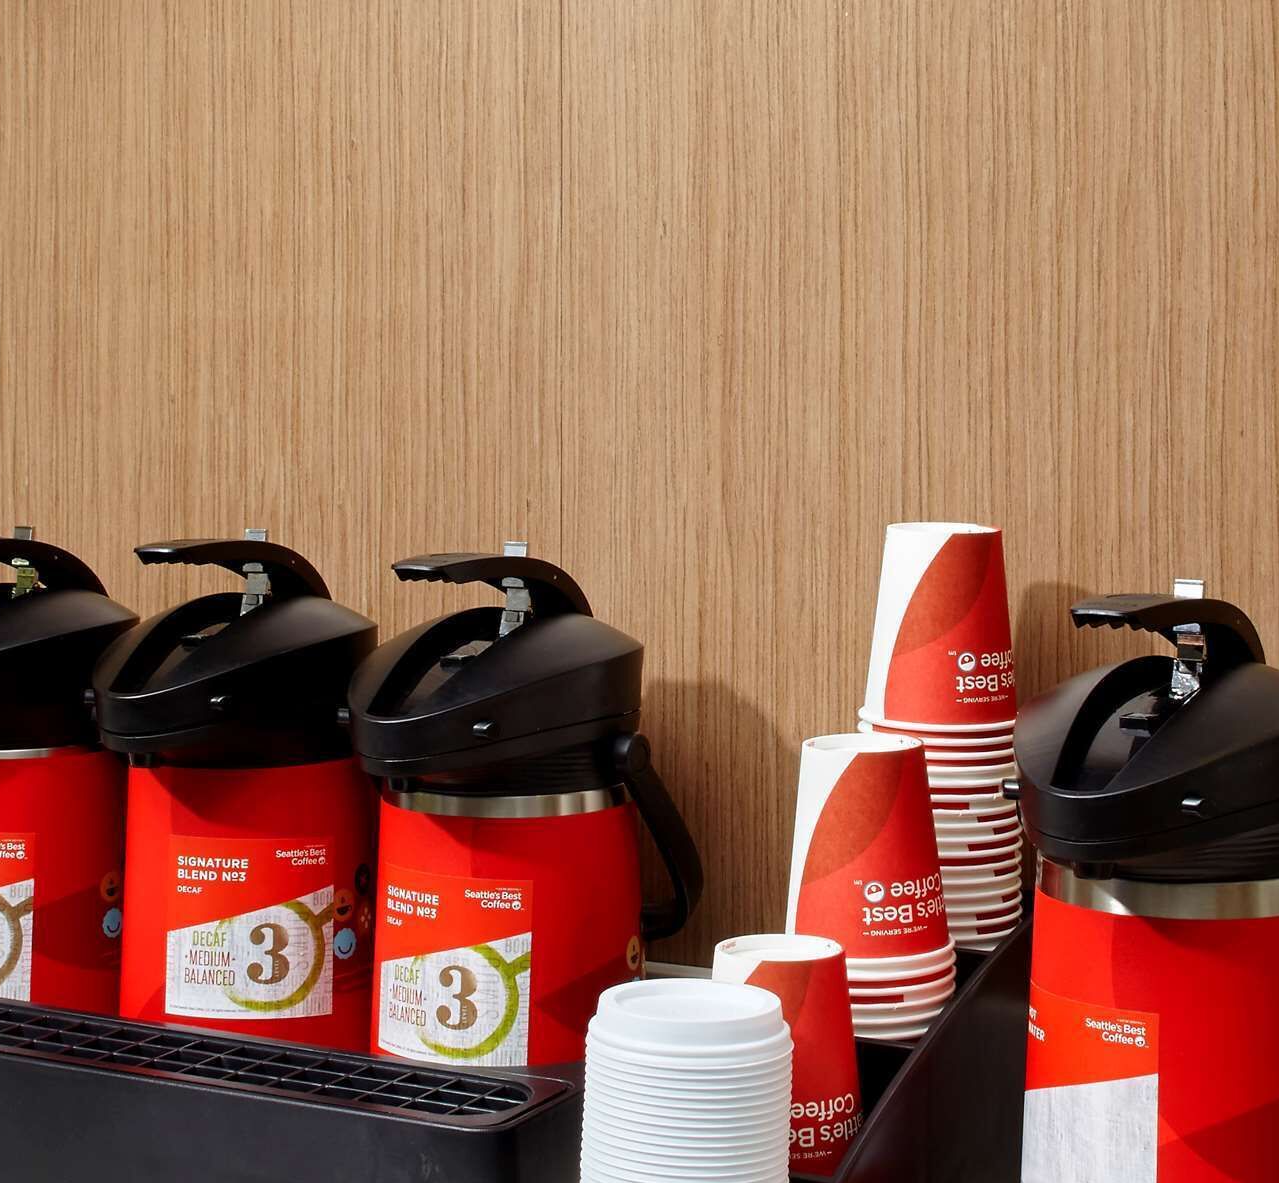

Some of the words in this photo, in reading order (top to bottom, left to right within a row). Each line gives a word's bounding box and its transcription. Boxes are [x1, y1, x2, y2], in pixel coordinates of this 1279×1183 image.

[956, 674, 998, 693] Best
[275, 850, 308, 858] Seattle's
[310, 848, 326, 856] Best
[177, 856, 249, 869] SIGNATURE
[292, 858, 317, 866] Coffee
[177, 870, 217, 881] BLEND
[177, 885, 202, 894] DECAF
[890, 872, 941, 899] Coffee
[387, 885, 439, 906] SIGNATURE
[464, 890, 500, 900] Seattle's
[501, 892, 522, 900] Best
[387, 898, 414, 915] BLEND
[481, 900, 511, 909] Coffee
[387, 916, 402, 927] DECAF
[862, 904, 913, 926] Best
[192, 931, 227, 947] DECAF
[870, 928, 902, 936] SERVING
[246, 922, 290, 985] 3
[184, 967, 236, 986] BALANCED
[394, 964, 420, 984] DECAF
[436, 965, 478, 1030] 3
[388, 1002, 426, 1027] BALANCED
[1085, 1018, 1122, 1032] Seattle's
[1123, 1024, 1146, 1036] Best
[1102, 1032, 1134, 1044] Coffee
[791, 1093, 854, 1122] Coffee
